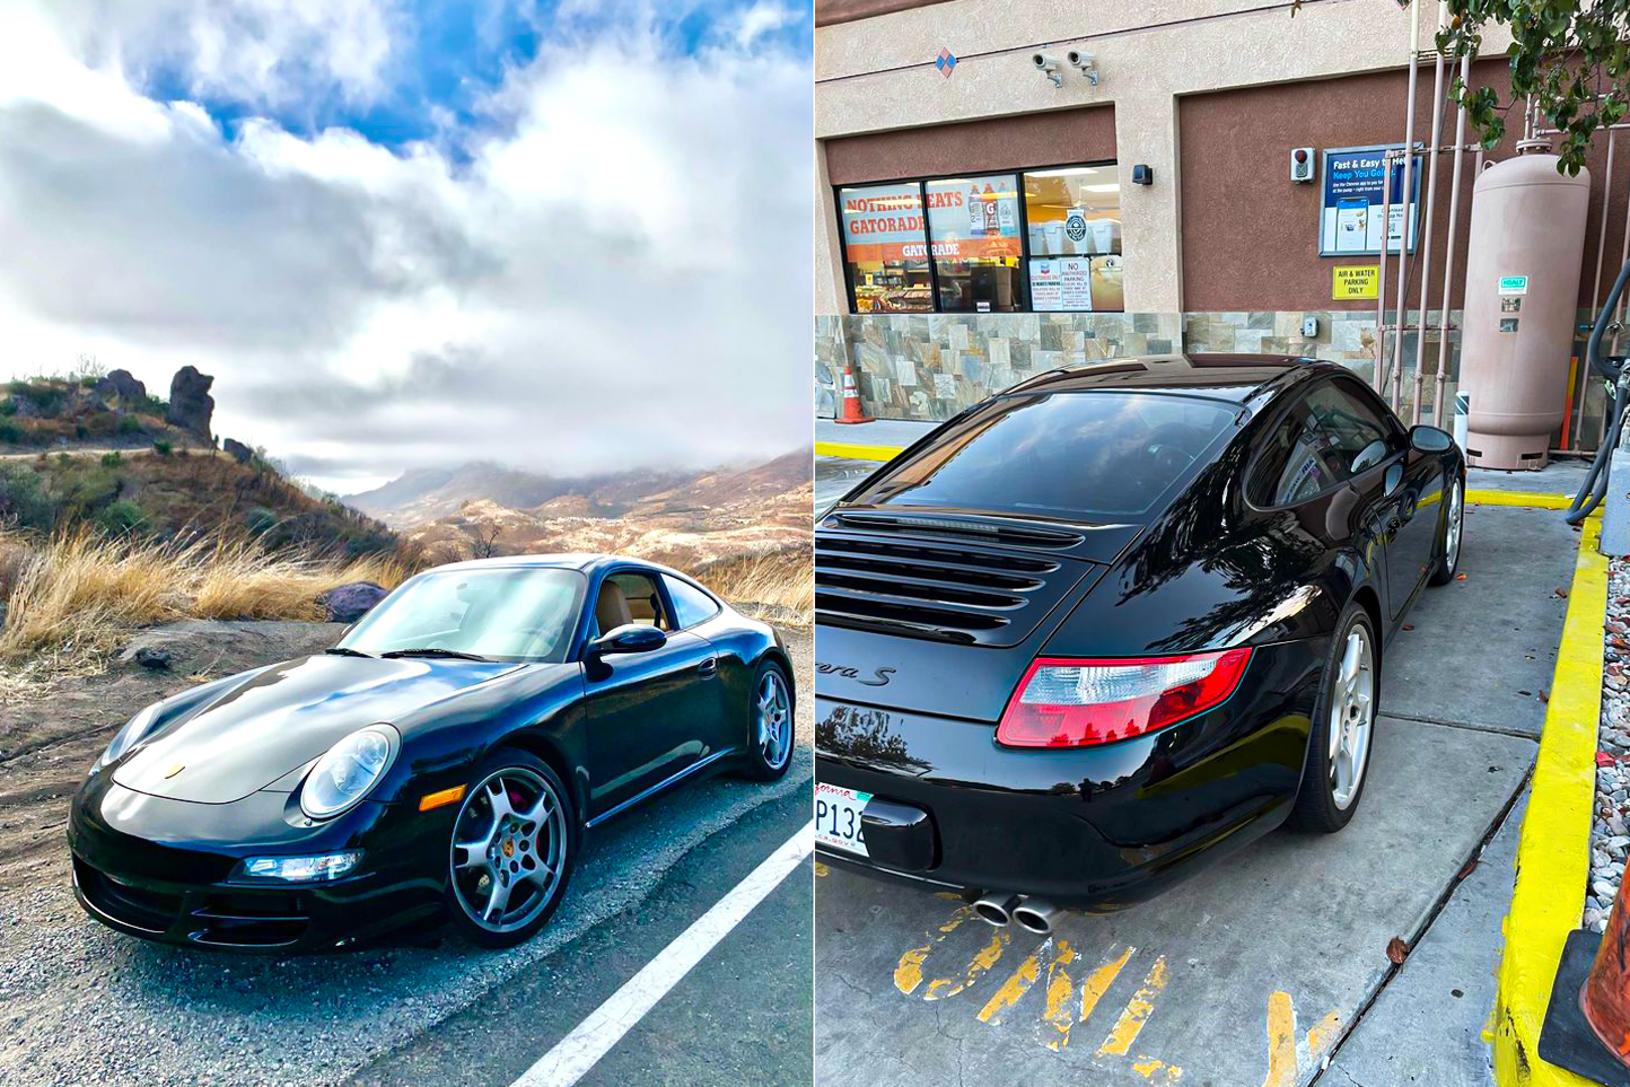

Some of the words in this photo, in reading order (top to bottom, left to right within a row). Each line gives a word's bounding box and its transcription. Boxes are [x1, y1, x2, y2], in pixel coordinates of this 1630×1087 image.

[1333, 160, 1350, 169] Fast
[1352, 160, 1358, 168] &
[1360, 159, 1380, 168] Easy
[1354, 169, 1369, 177] You
[846, 195, 913, 213] NOTHING
[1068, 262, 1079, 270] NO
[1355, 269, 1375, 277] WATER
[857, 667, 897, 687] S
